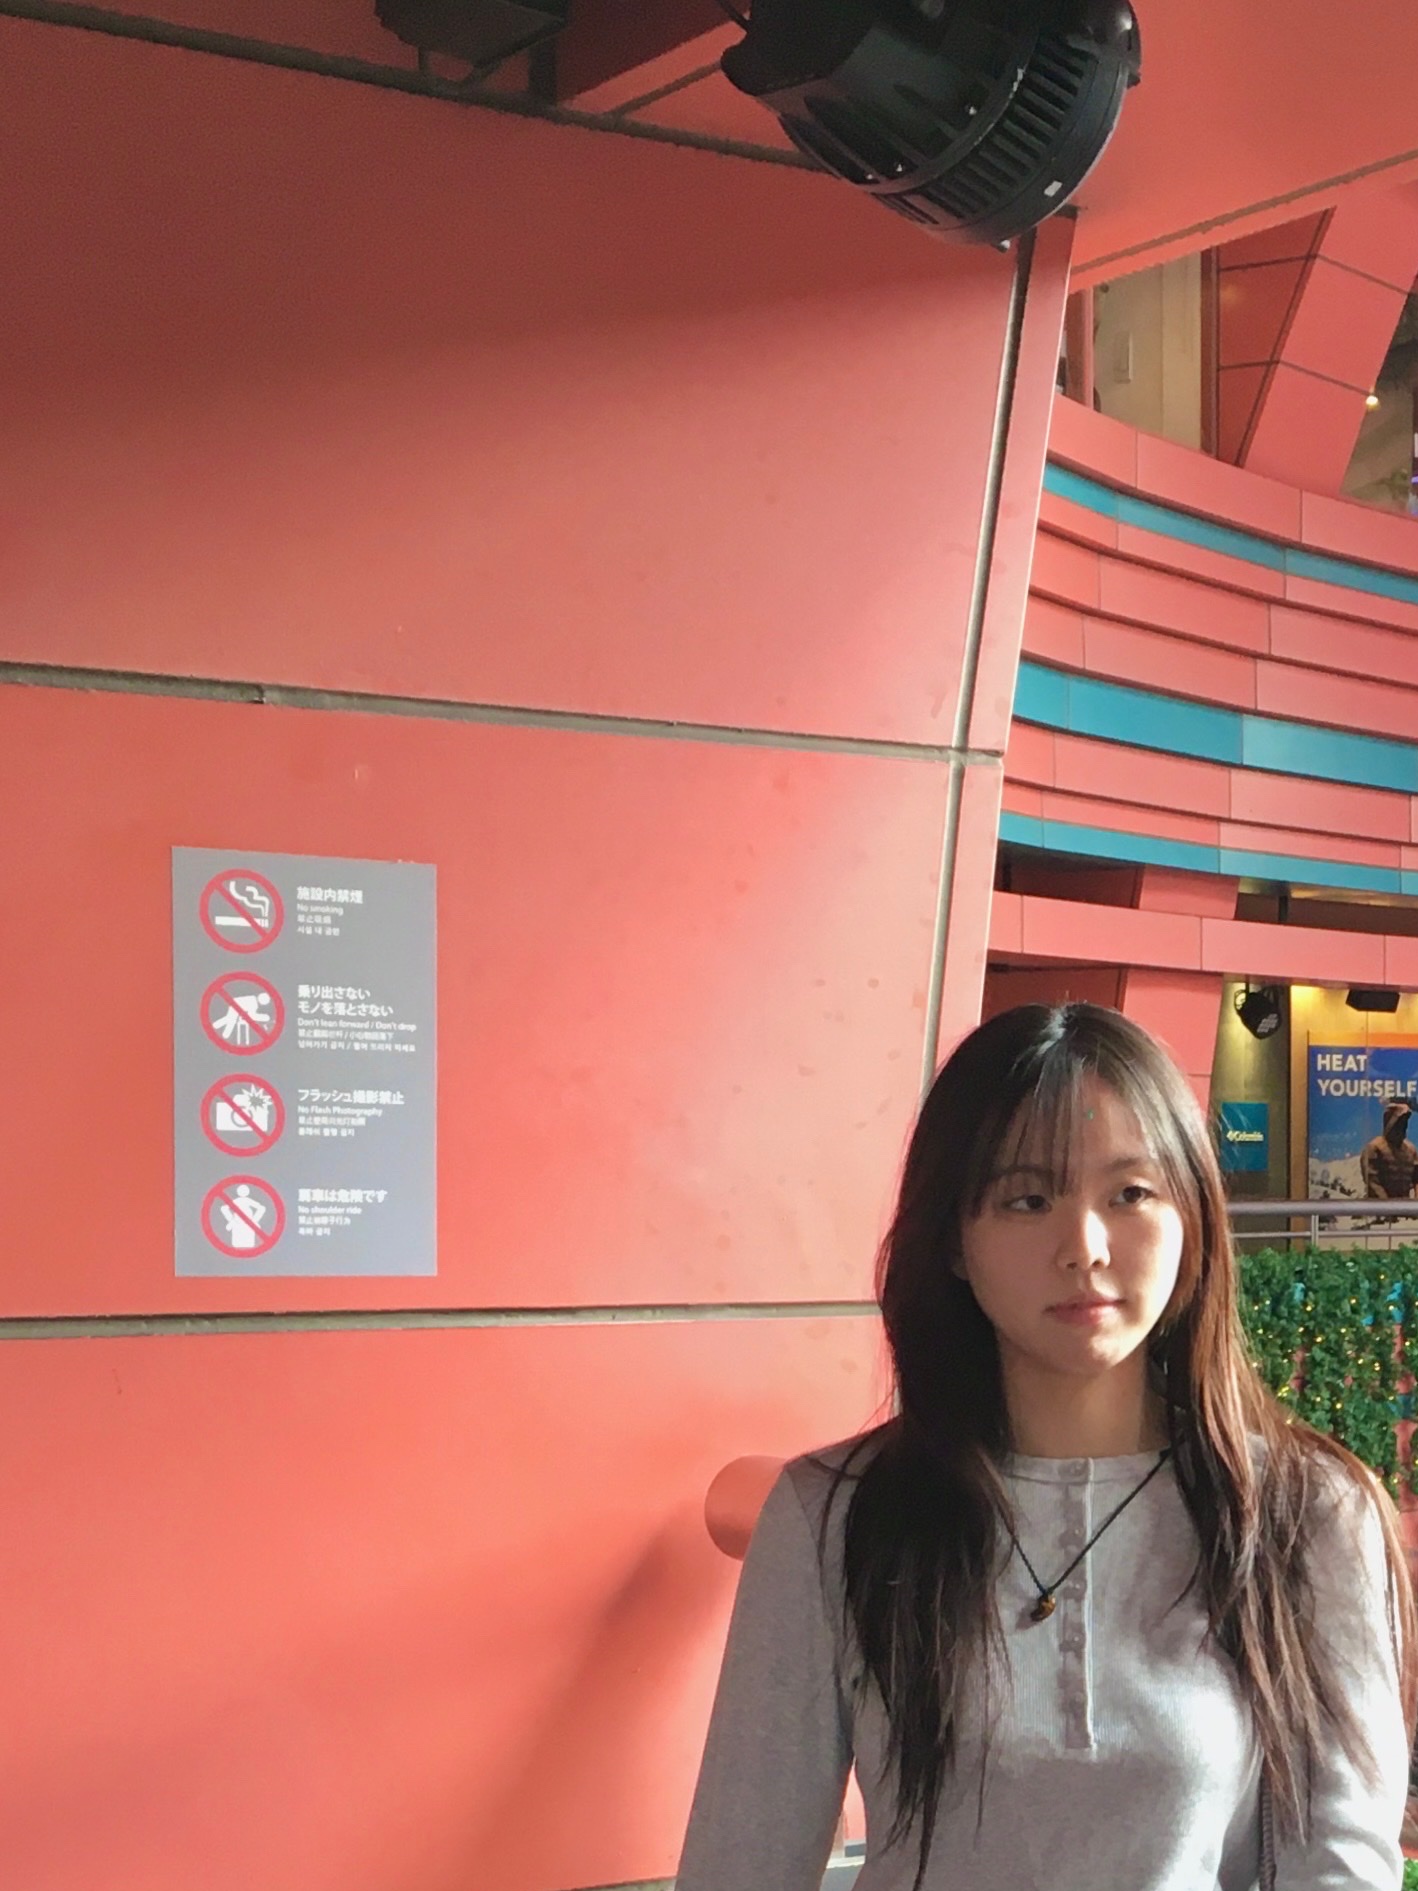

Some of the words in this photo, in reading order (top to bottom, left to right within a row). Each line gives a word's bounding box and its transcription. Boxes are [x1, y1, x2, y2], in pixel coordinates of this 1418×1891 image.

[298, 1001, 394, 1017] モノを落とさない
[298, 1017, 319, 1027] Don't
[339, 1019, 370, 1029] forward
[376, 1021, 397, 1031] Don't
[398, 1023, 417, 1033] drop
[1316, 1054, 1368, 1072] HEAT
[298, 1088, 405, 1105] フラッシュ撮影禁止
[1317, 1079, 1418, 1098] YOURSELF
[298, 1105, 309, 1114] No
[311, 1105, 331, 1114] Flash
[332, 1106, 383, 1118] Photography
[298, 1205, 310, 1214] No
[311, 1205, 345, 1214] shoulder
[346, 1206, 362, 1215] ride
